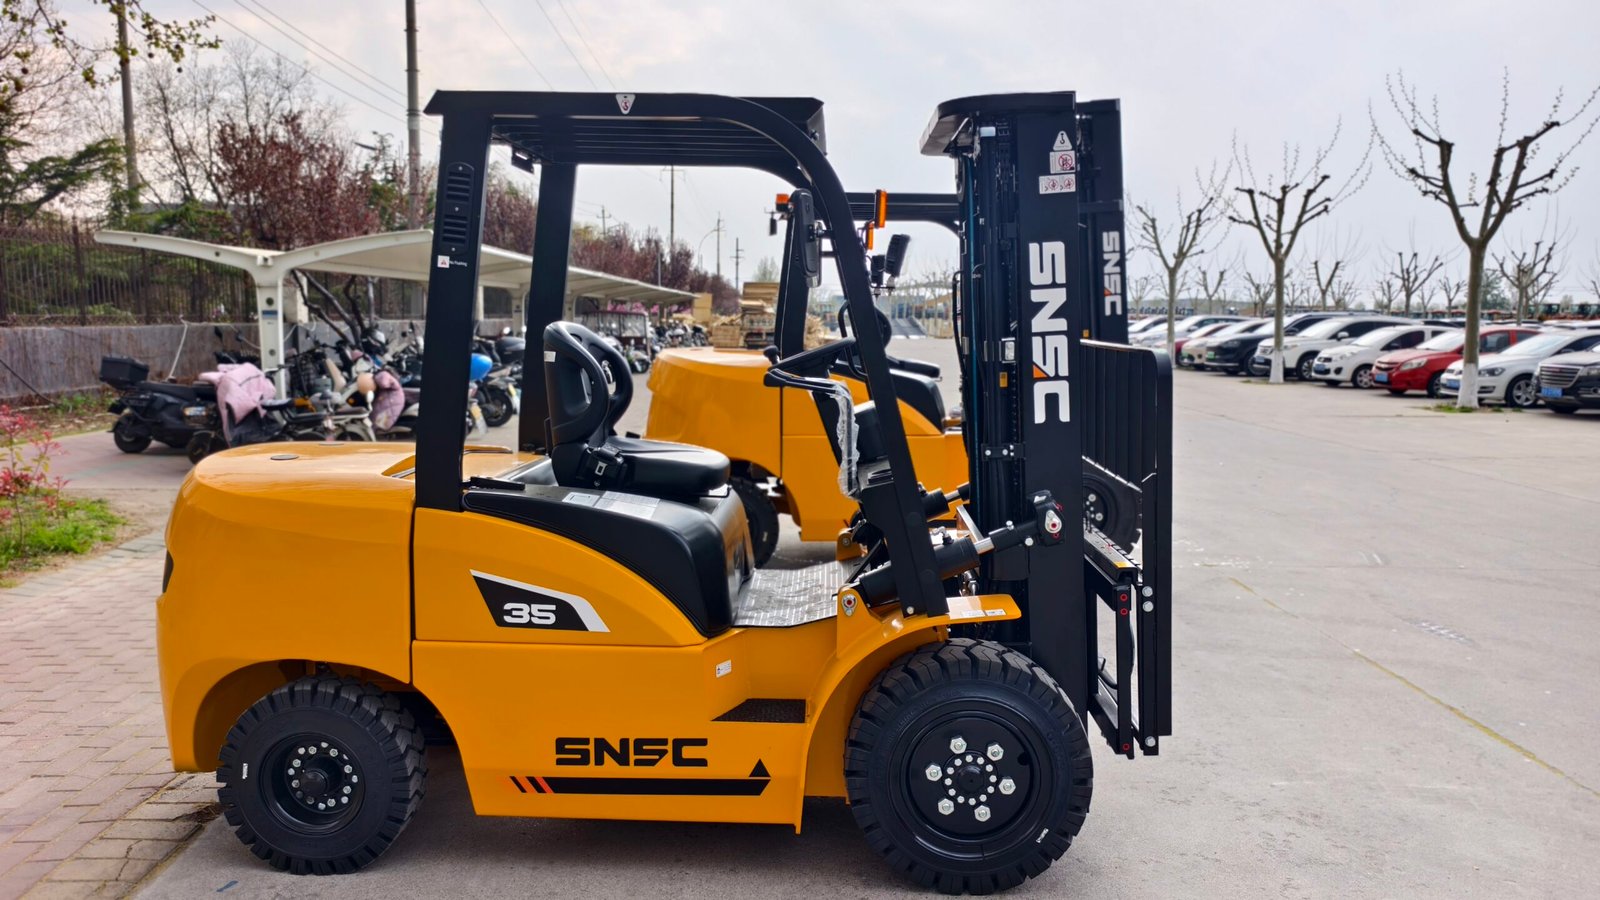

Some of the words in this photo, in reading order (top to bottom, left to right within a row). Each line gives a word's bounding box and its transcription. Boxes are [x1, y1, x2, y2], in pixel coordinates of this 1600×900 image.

[1102, 230, 1122, 316] SNSC
[1028, 241, 1071, 425] SNSC
[502, 602, 557, 626] 35
[555, 737, 708, 768] SNSC
